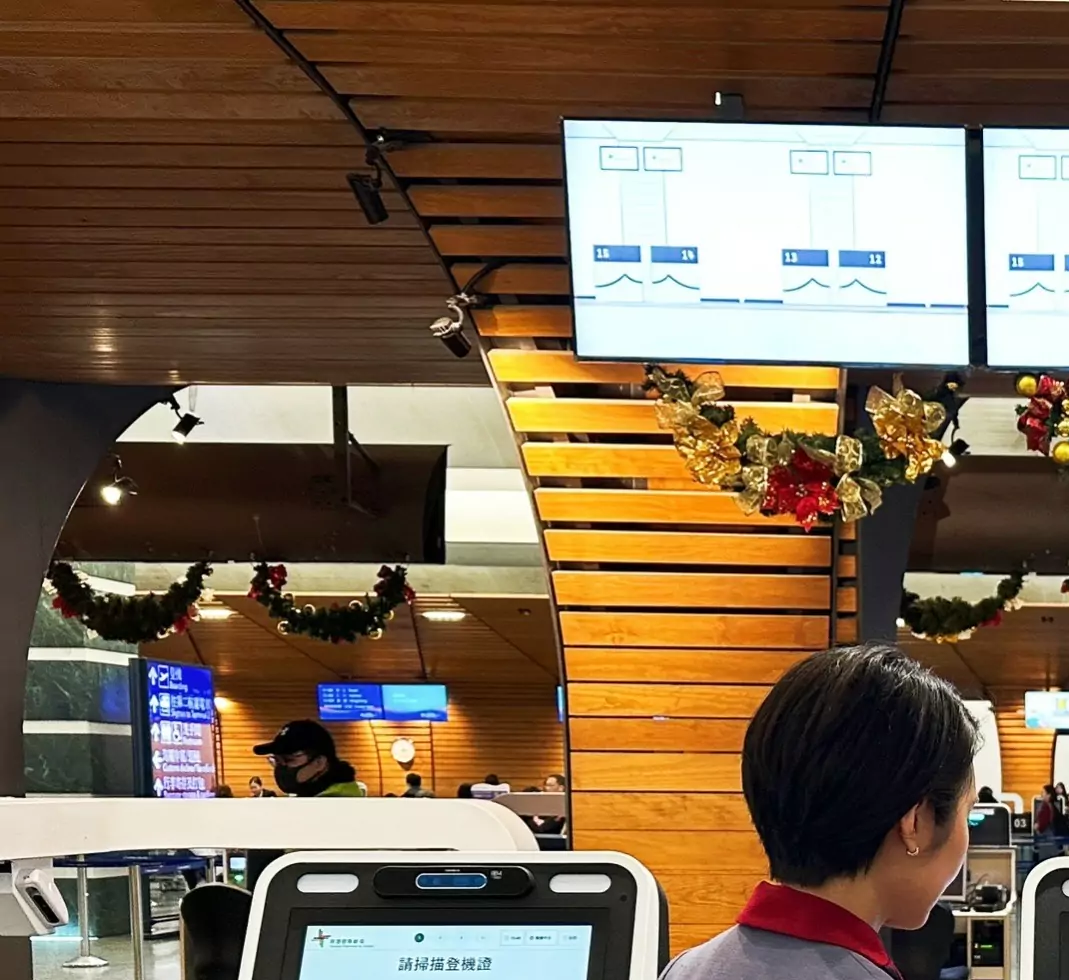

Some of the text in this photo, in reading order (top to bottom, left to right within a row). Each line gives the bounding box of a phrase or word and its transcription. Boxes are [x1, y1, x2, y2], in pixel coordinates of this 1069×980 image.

[681, 250, 695, 260] 14
[784, 252, 798, 263] 13
[869, 254, 882, 264] 12
[1014, 818, 1027, 829] 03
[398, 956, 492, 971] 請掃描登機證
